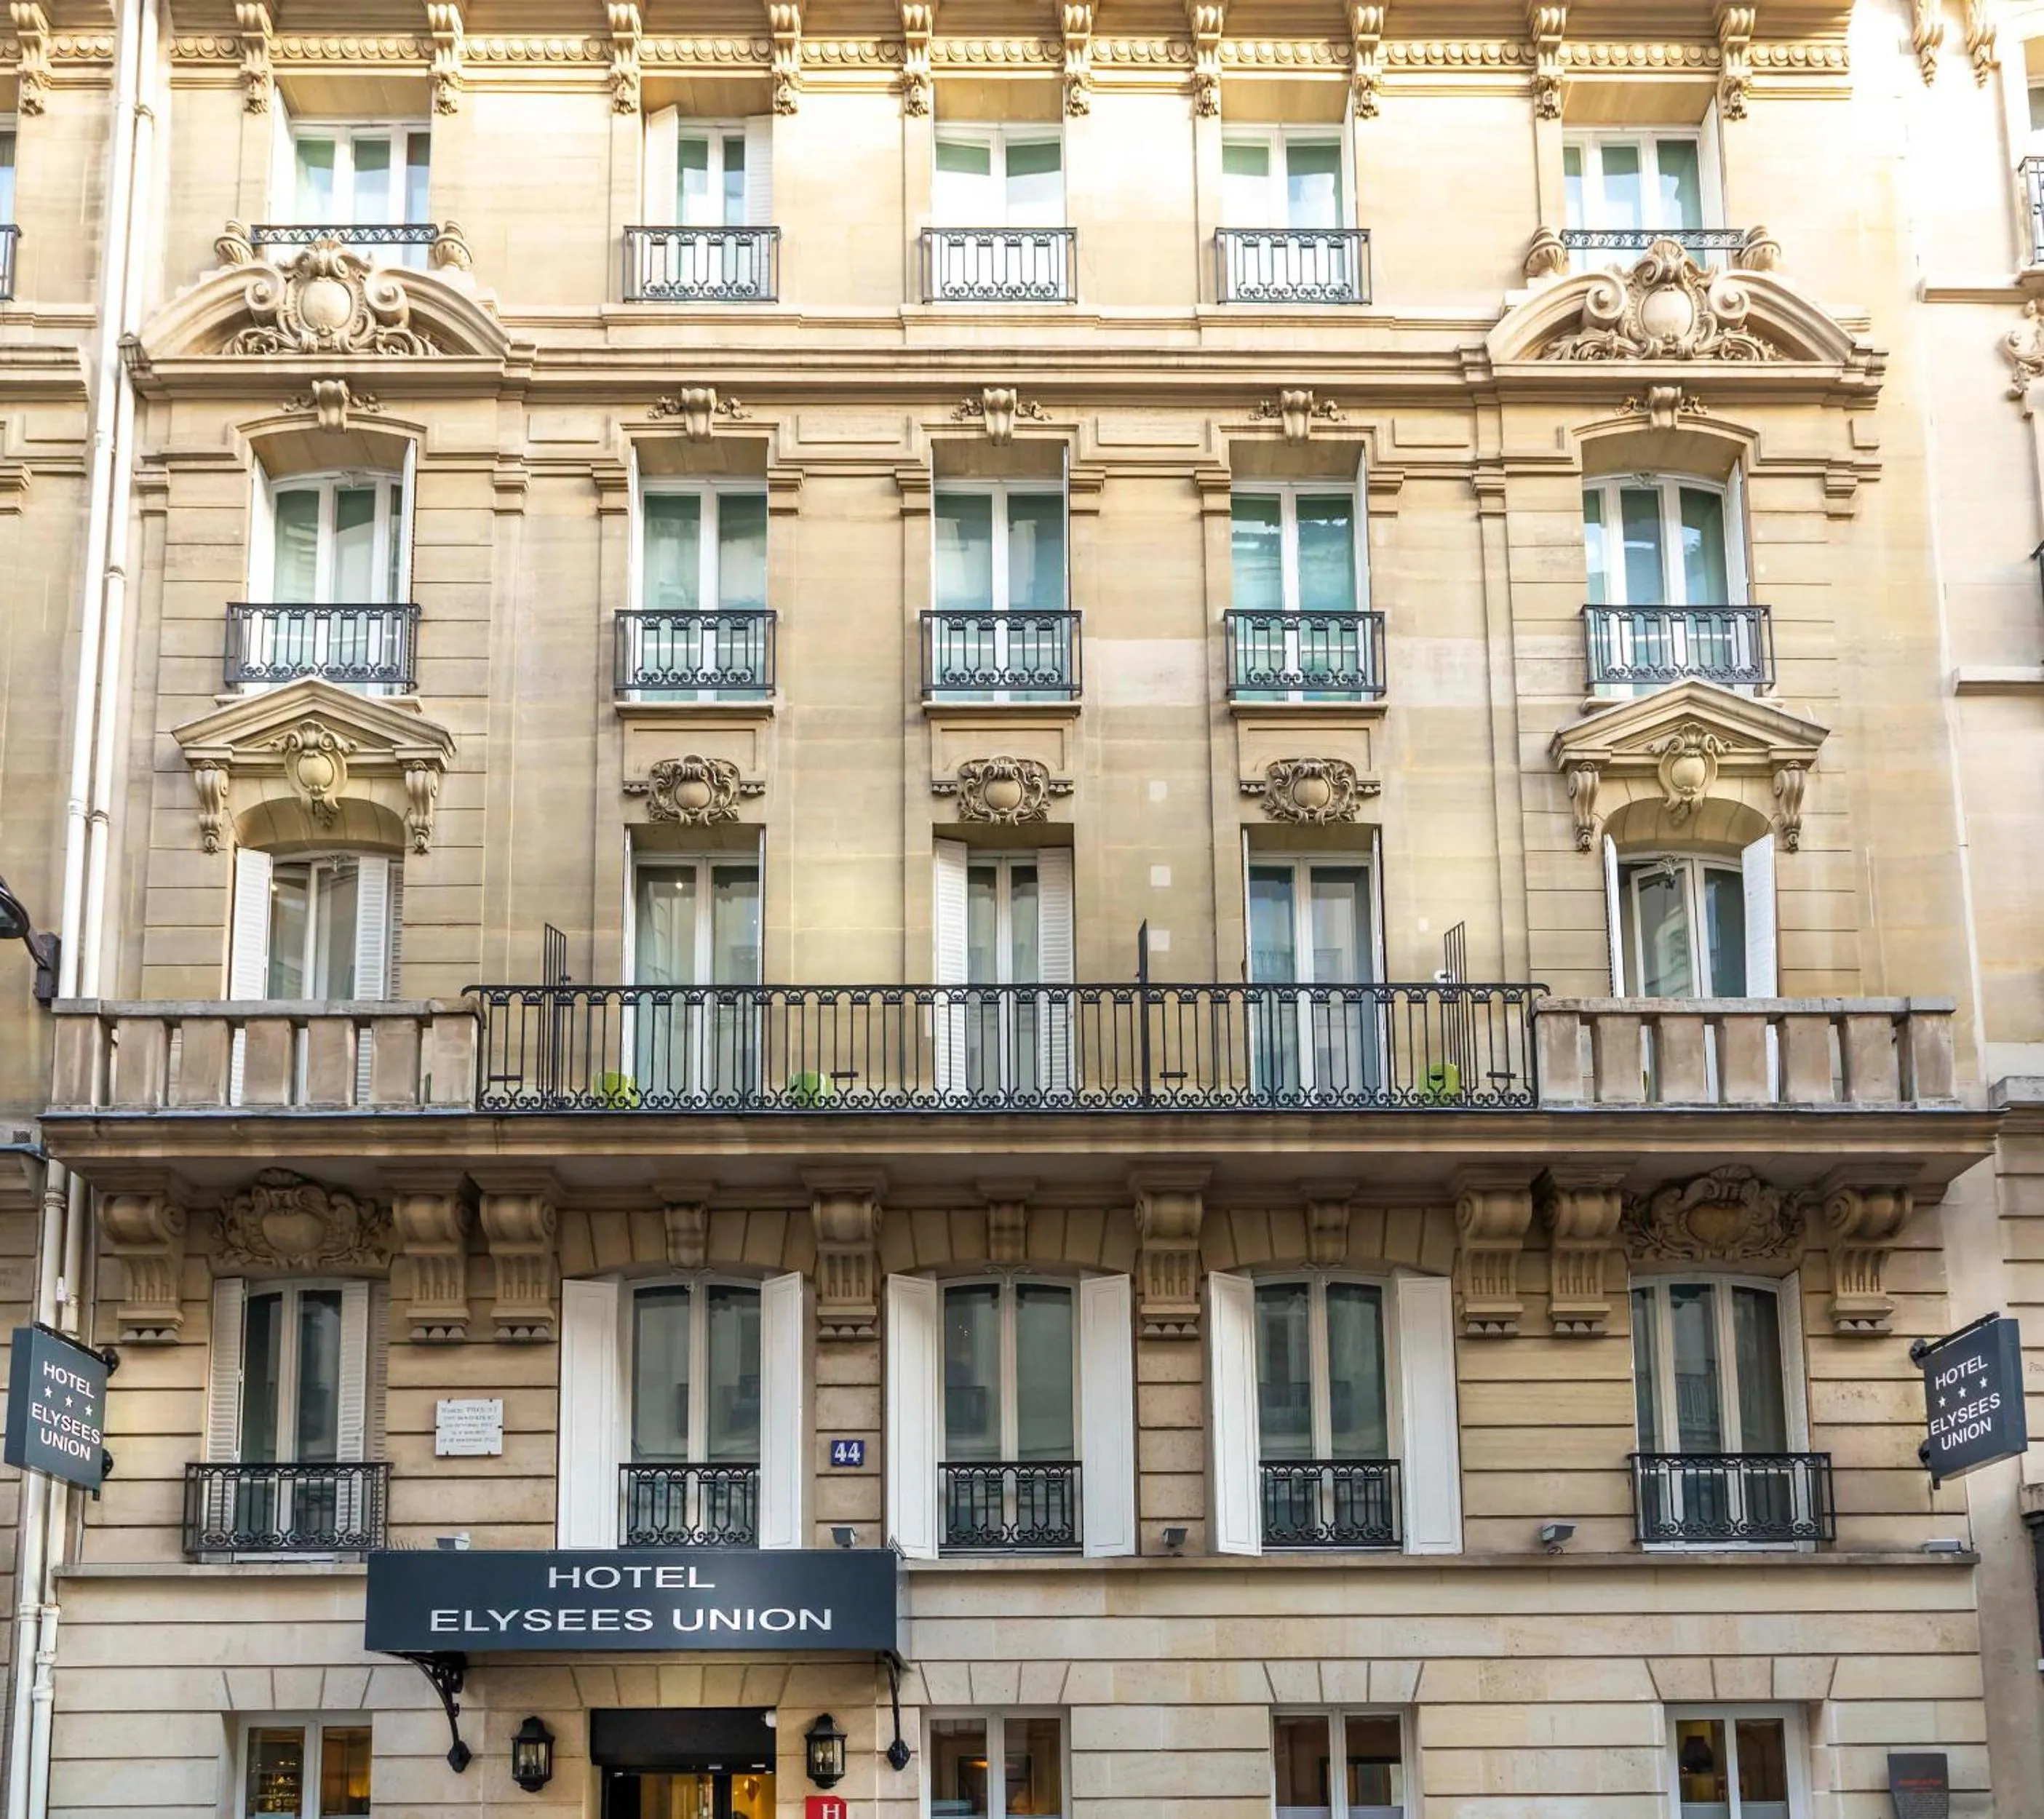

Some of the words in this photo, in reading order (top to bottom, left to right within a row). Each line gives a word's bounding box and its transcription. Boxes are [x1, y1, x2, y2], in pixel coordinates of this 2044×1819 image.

[43, 1361, 95, 1398] HOTEL
[1935, 1355, 1988, 1390] HOTEL
[31, 1402, 101, 1444] ELYSEES
[1930, 1393, 2001, 1436] ELYSEES
[41, 1428, 91, 1461] UNION
[1941, 1417, 1992, 1450] UNION
[835, 1442, 861, 1462] 44
[548, 1567, 715, 1589] HOTEL
[429, 1609, 654, 1632] ELYSEES
[672, 1608, 832, 1631] UNION
[822, 1803, 840, 1819] H
